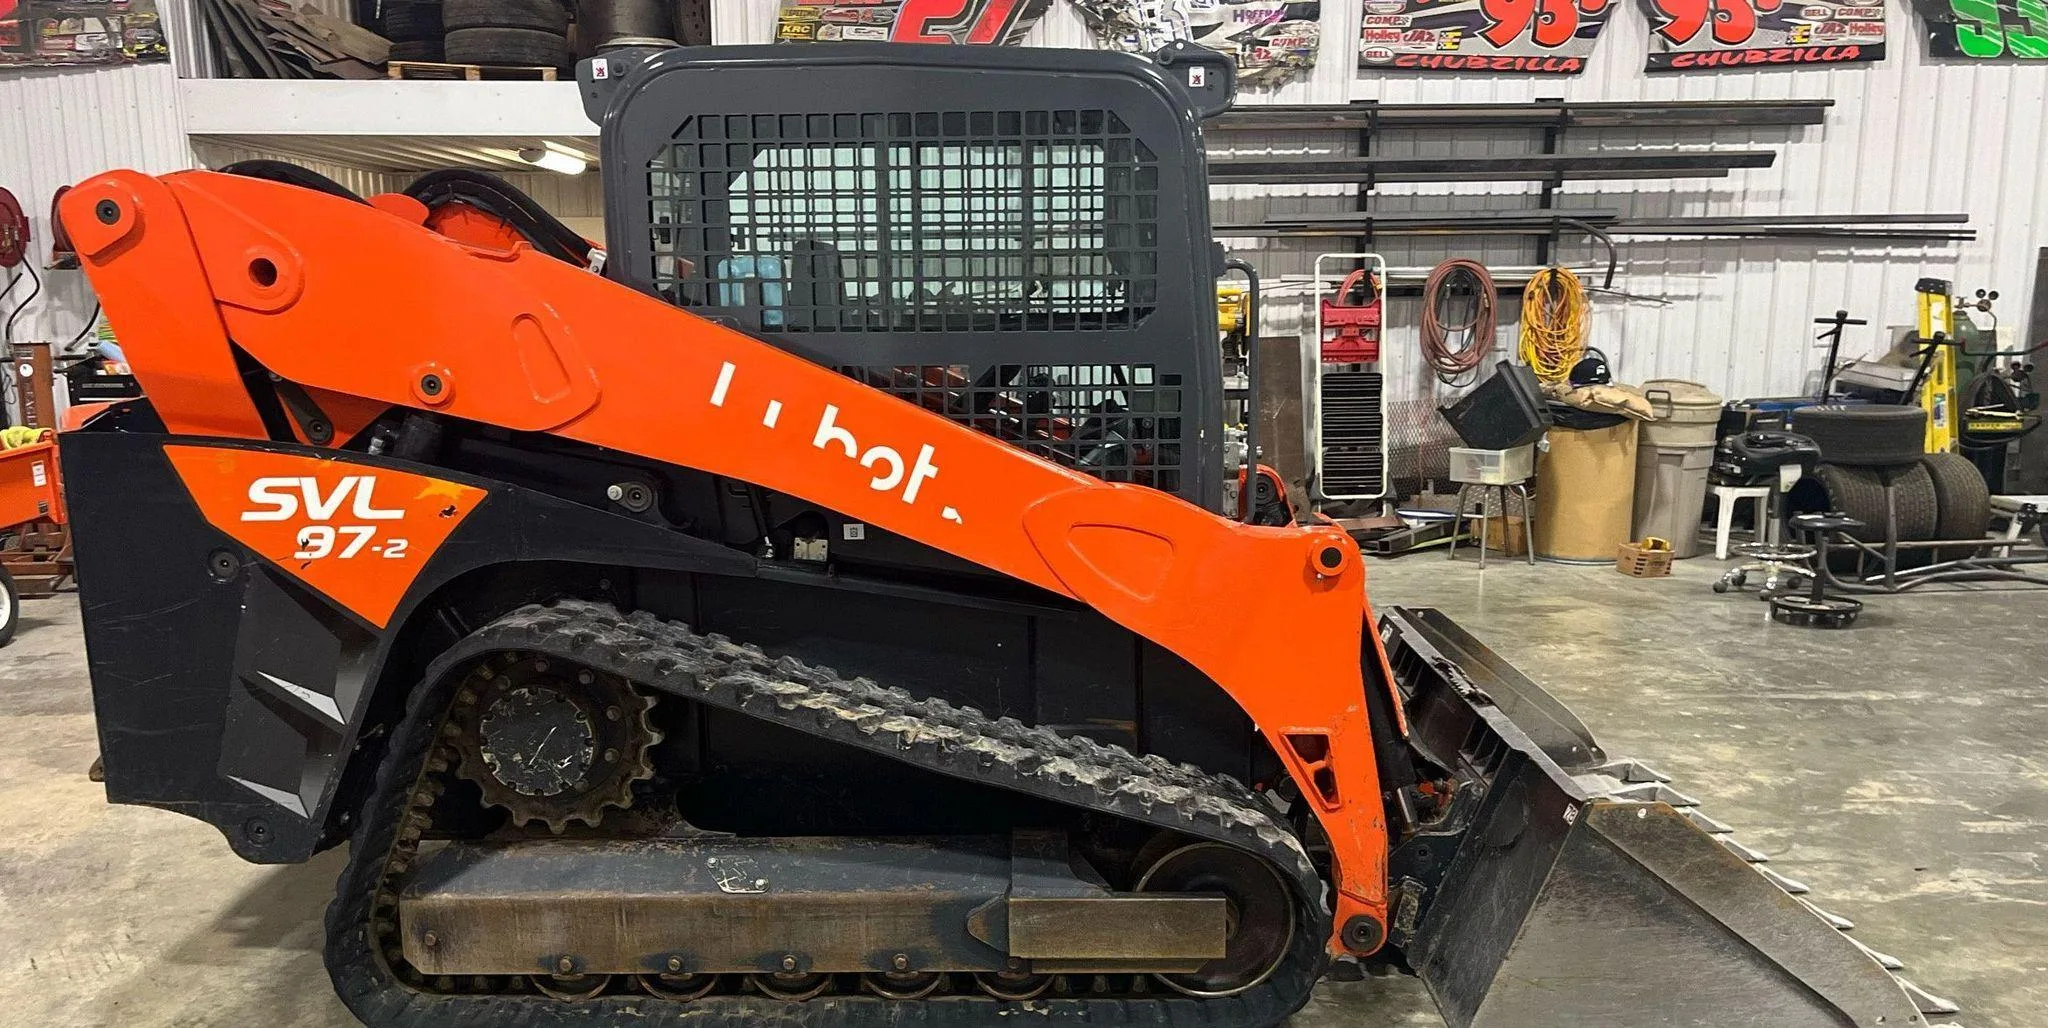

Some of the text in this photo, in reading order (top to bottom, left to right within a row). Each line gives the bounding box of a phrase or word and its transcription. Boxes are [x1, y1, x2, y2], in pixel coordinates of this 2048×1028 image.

[1803, 8, 1829, 17] BELL
[781, 24, 811, 34] KRC
[1364, 28, 1400, 41] Holley
[1848, 22, 1885, 34] Holley
[1365, 50, 1390, 58] BELL
[1670, 45, 1861, 68] CHUBZILLA
[1394, 54, 1582, 72] CHUBZILLA
[240, 475, 406, 522] SVL
[293, 525, 409, 560] 97-2
